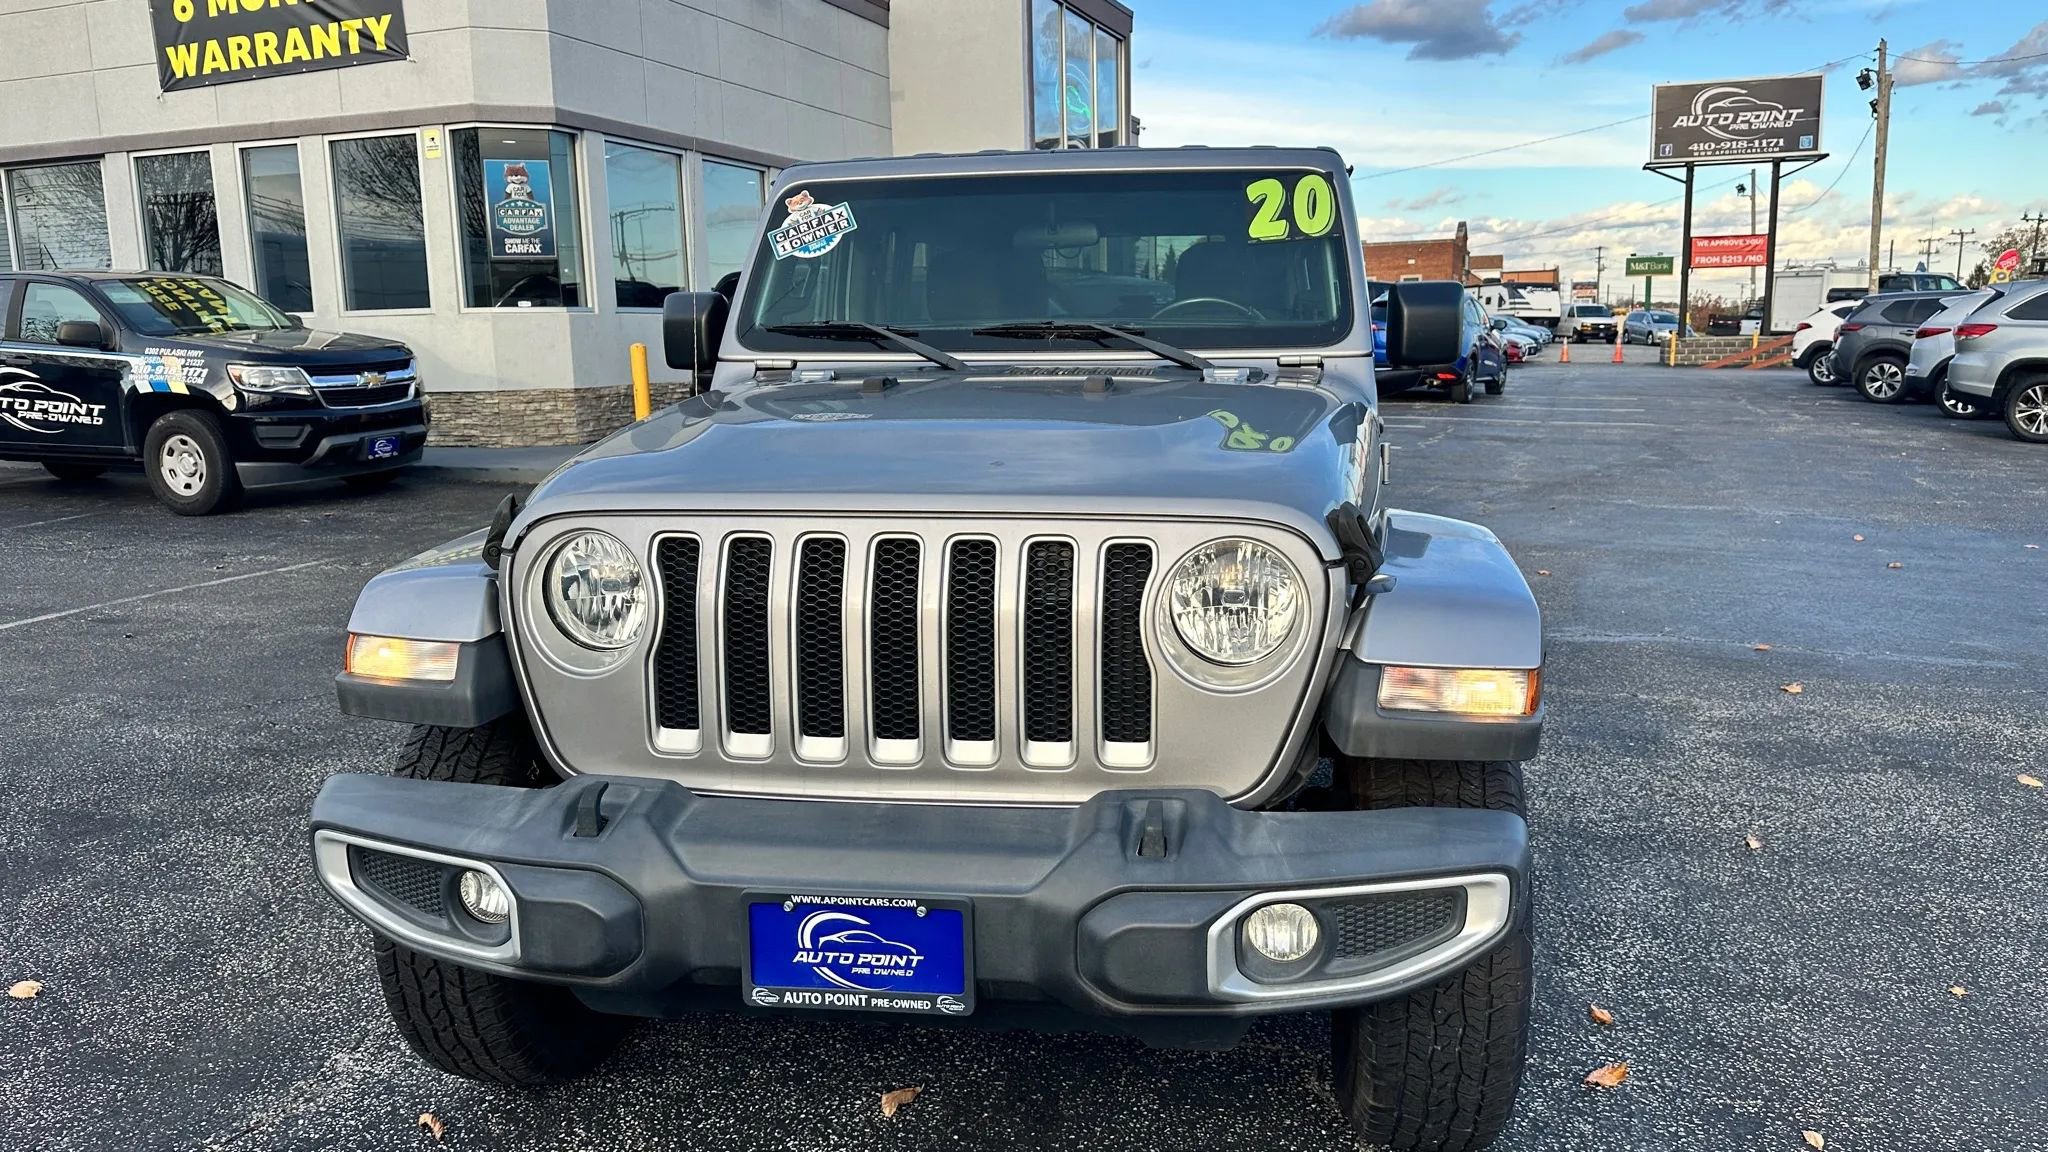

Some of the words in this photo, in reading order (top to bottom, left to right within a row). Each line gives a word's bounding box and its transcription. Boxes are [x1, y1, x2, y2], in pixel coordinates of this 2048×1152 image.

[165, 14, 393, 79] WARRANTY
[1672, 113, 1734, 127] AUTO
[1736, 109, 1804, 124] POINT
[1729, 123, 1749, 131] PRE
[1751, 121, 1794, 129] OWNED
[1688, 138, 1785, 151] 410-918-1171
[499, 209, 542, 217] CARFAX
[1246, 174, 1335, 241] 20
[775, 210, 845, 243] CARFAX
[791, 220, 849, 248] OWNER
[505, 244, 542, 253] CARFAX
[1710, 238, 1743, 247] APPROVE
[1695, 256, 1720, 264] FROM
[159, 347, 187, 357] PULASKI
[187, 349, 205, 358] HWY
[33, 399, 106, 416] POINT
[17, 410, 104, 425] PRE-OWNED
[791, 895, 917, 908] WWW.APOINTCARS.COM
[792, 951, 854, 965] AUTO
[857, 953, 924, 967] POINT
[851, 967, 871, 975] PRE
[873, 968, 914, 977] OWNED
[783, 991, 822, 1005] AUTO
[825, 993, 868, 1007] POINT
[871, 997, 931, 1010] PRE-OWNED
